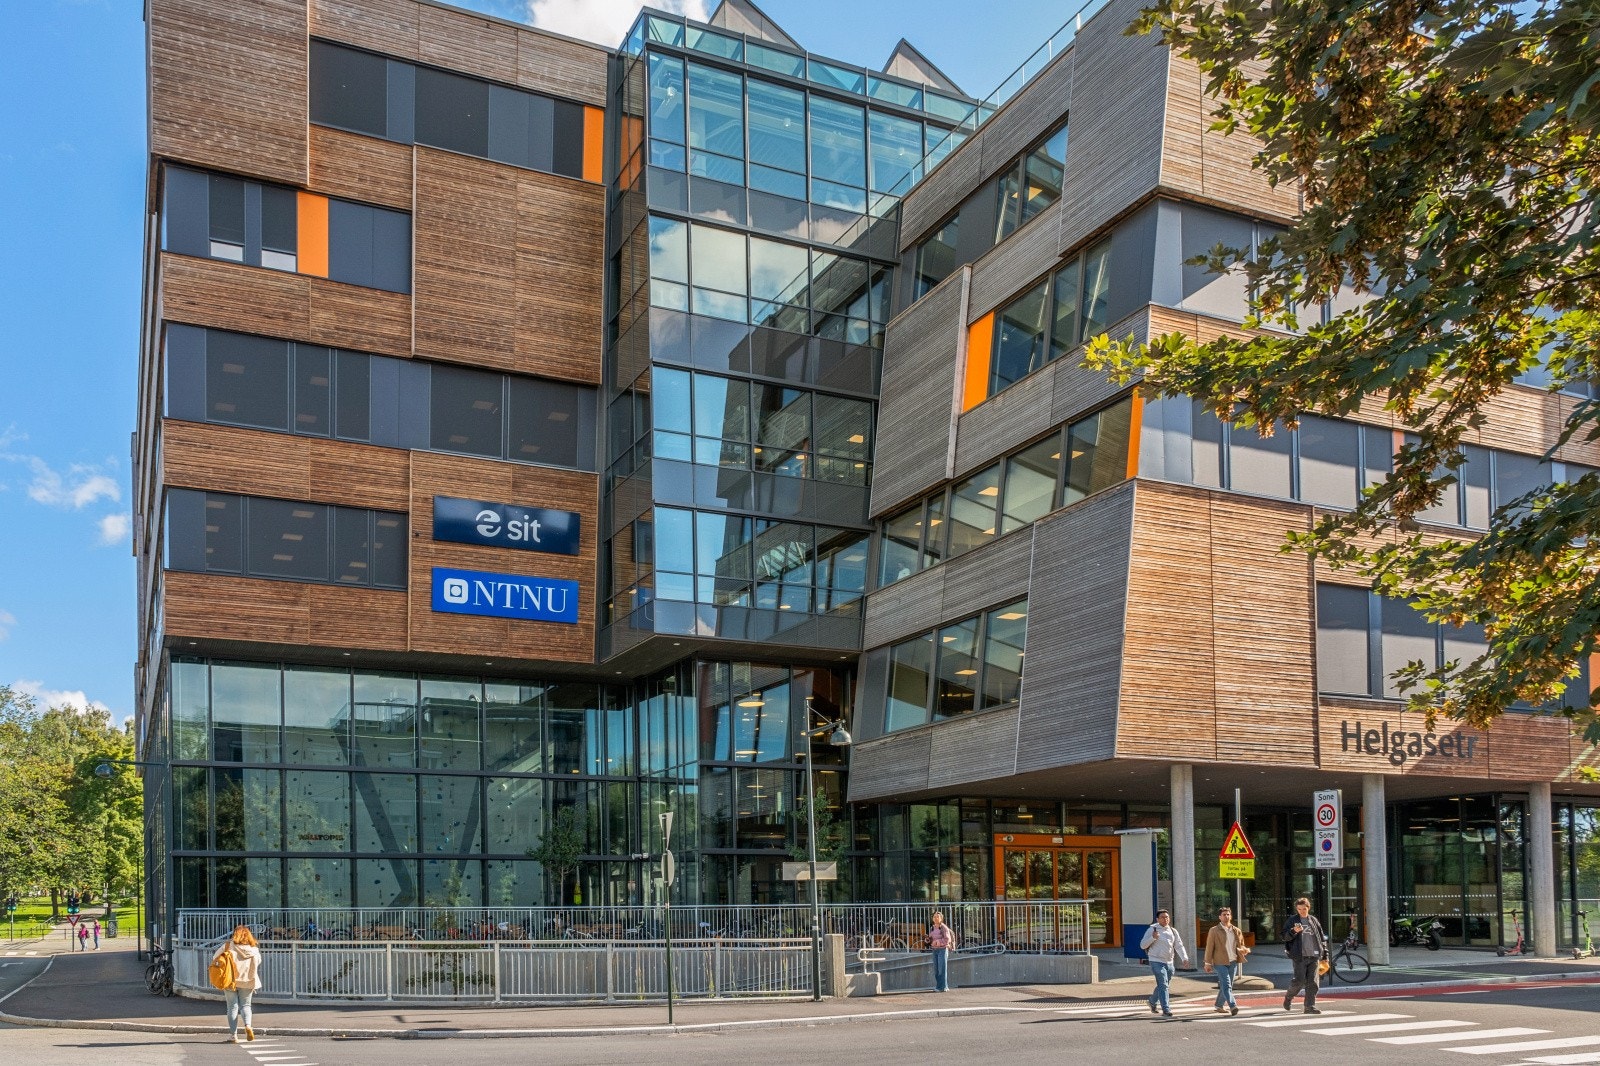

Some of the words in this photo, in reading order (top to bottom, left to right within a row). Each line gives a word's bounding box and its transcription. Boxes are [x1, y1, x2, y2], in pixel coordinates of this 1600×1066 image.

[507, 514, 541, 543] sit
[473, 580, 568, 613] NTNU
[1341, 720, 1479, 766] Helgasetr
[1318, 793, 1334, 801] Sone
[1320, 810, 1332, 820] 30
[1318, 831, 1335, 839] Sone
